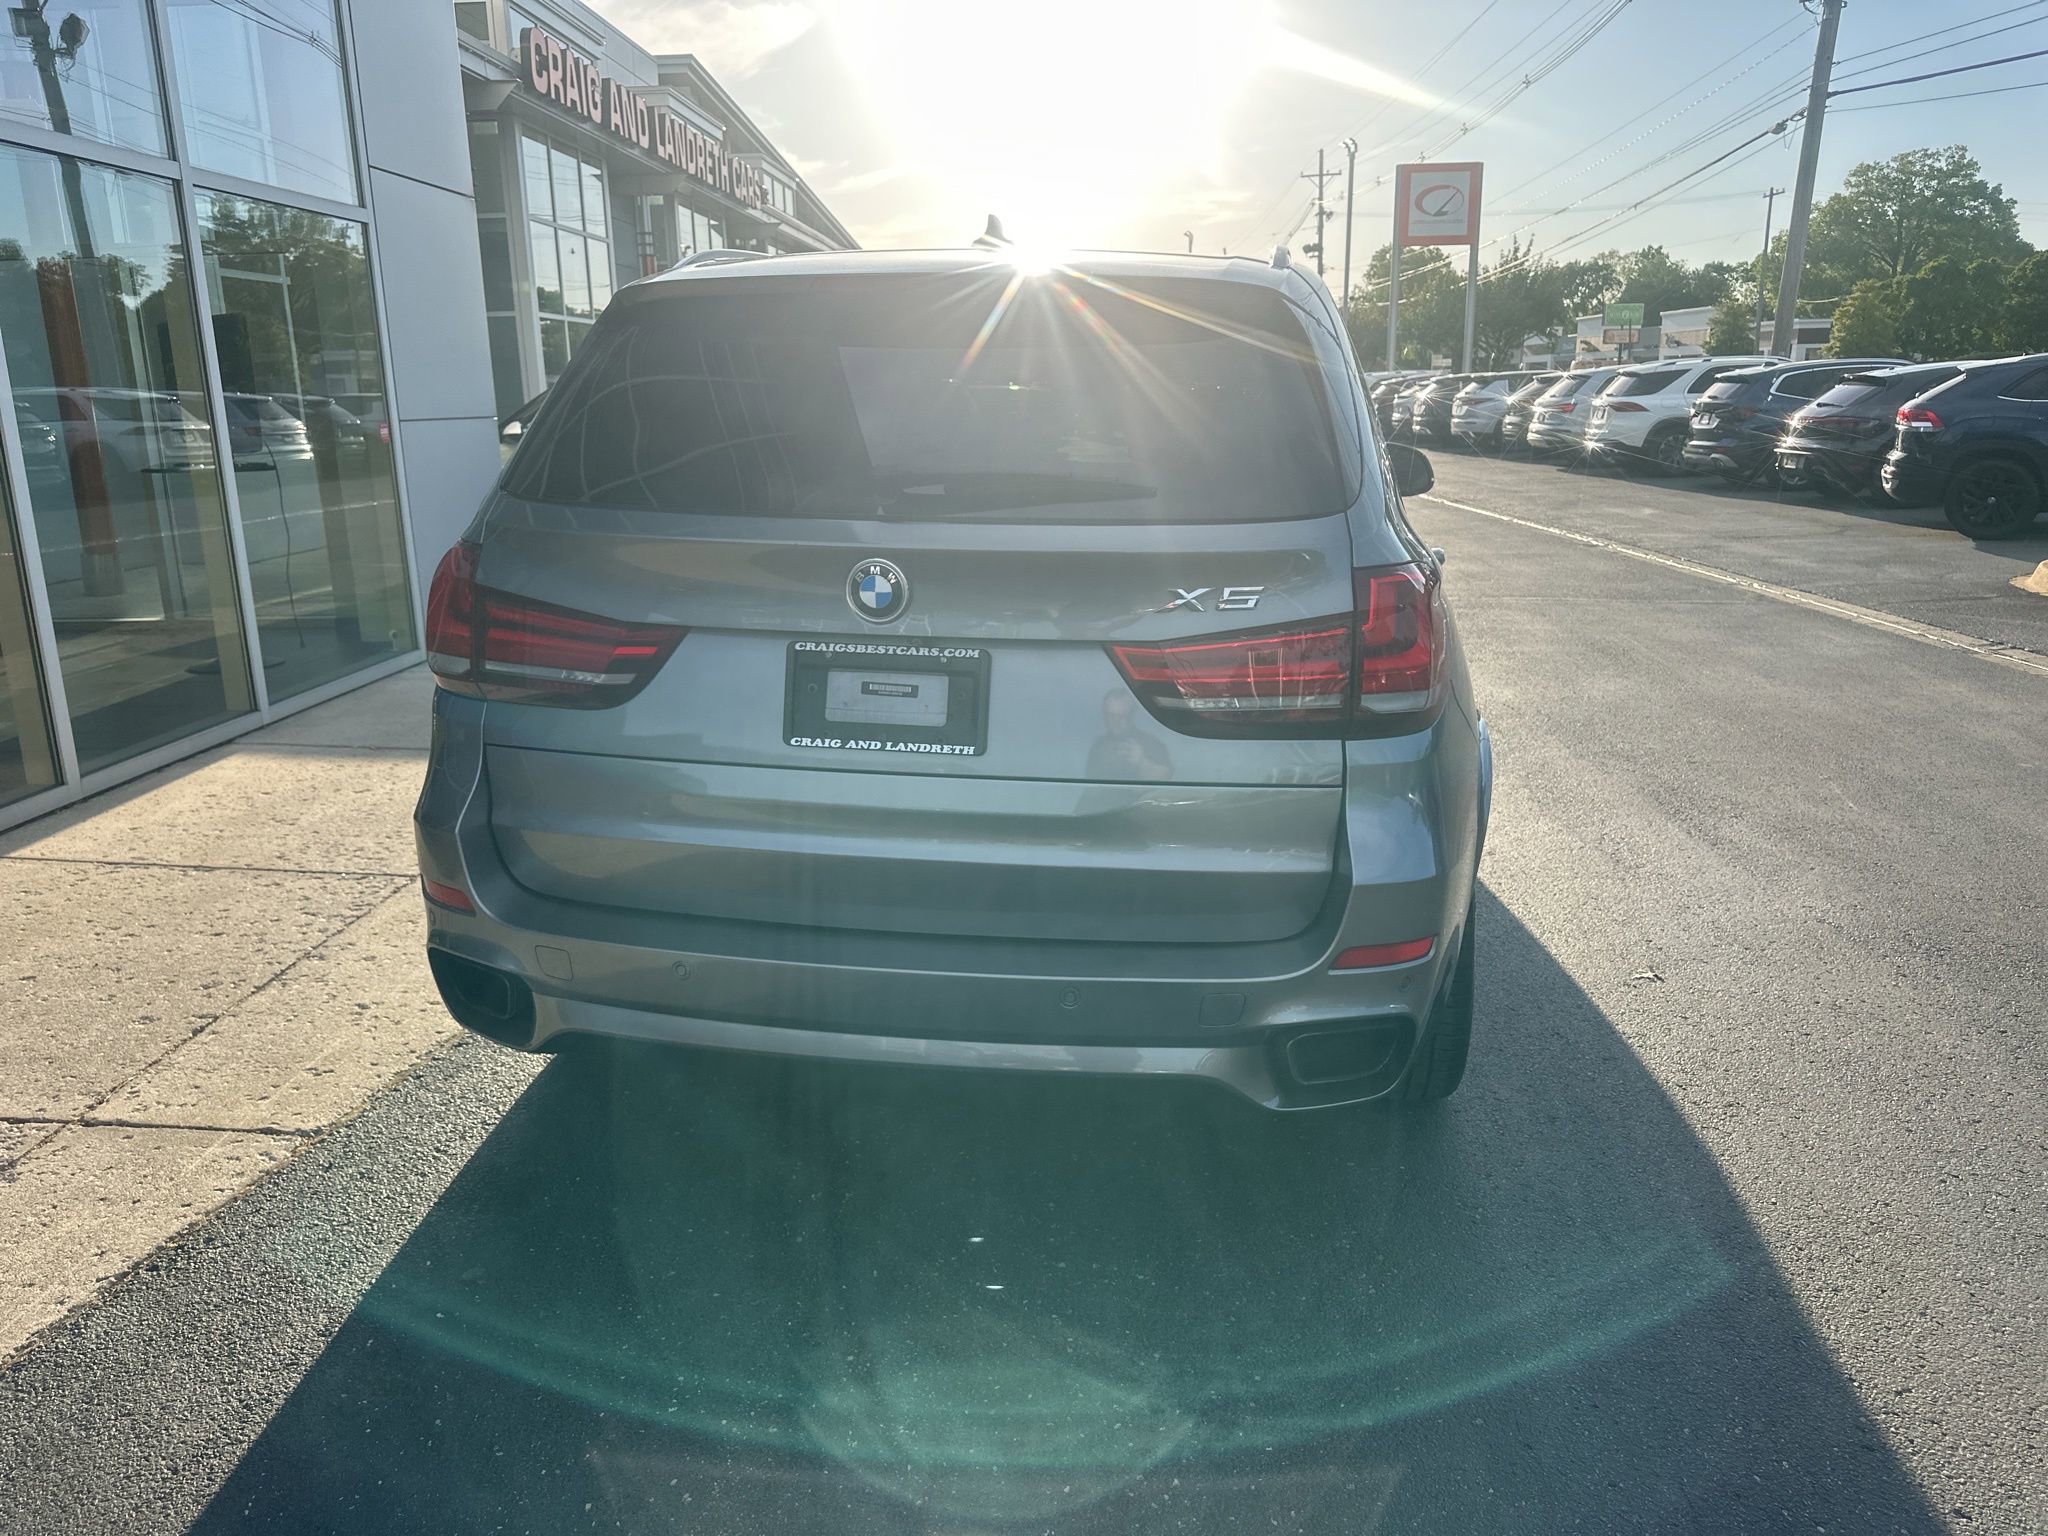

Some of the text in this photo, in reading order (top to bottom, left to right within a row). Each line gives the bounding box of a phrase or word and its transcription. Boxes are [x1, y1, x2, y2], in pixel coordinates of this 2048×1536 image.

[527, 26, 762, 210] CRAIG AND LANDRETH CARS
[855, 566, 897, 584] BMW
[1160, 586, 1265, 612] X5
[794, 641, 980, 659] CRAIGSBESTCARS.COM
[790, 737, 975, 755] CRAIG AND LANDRETH
